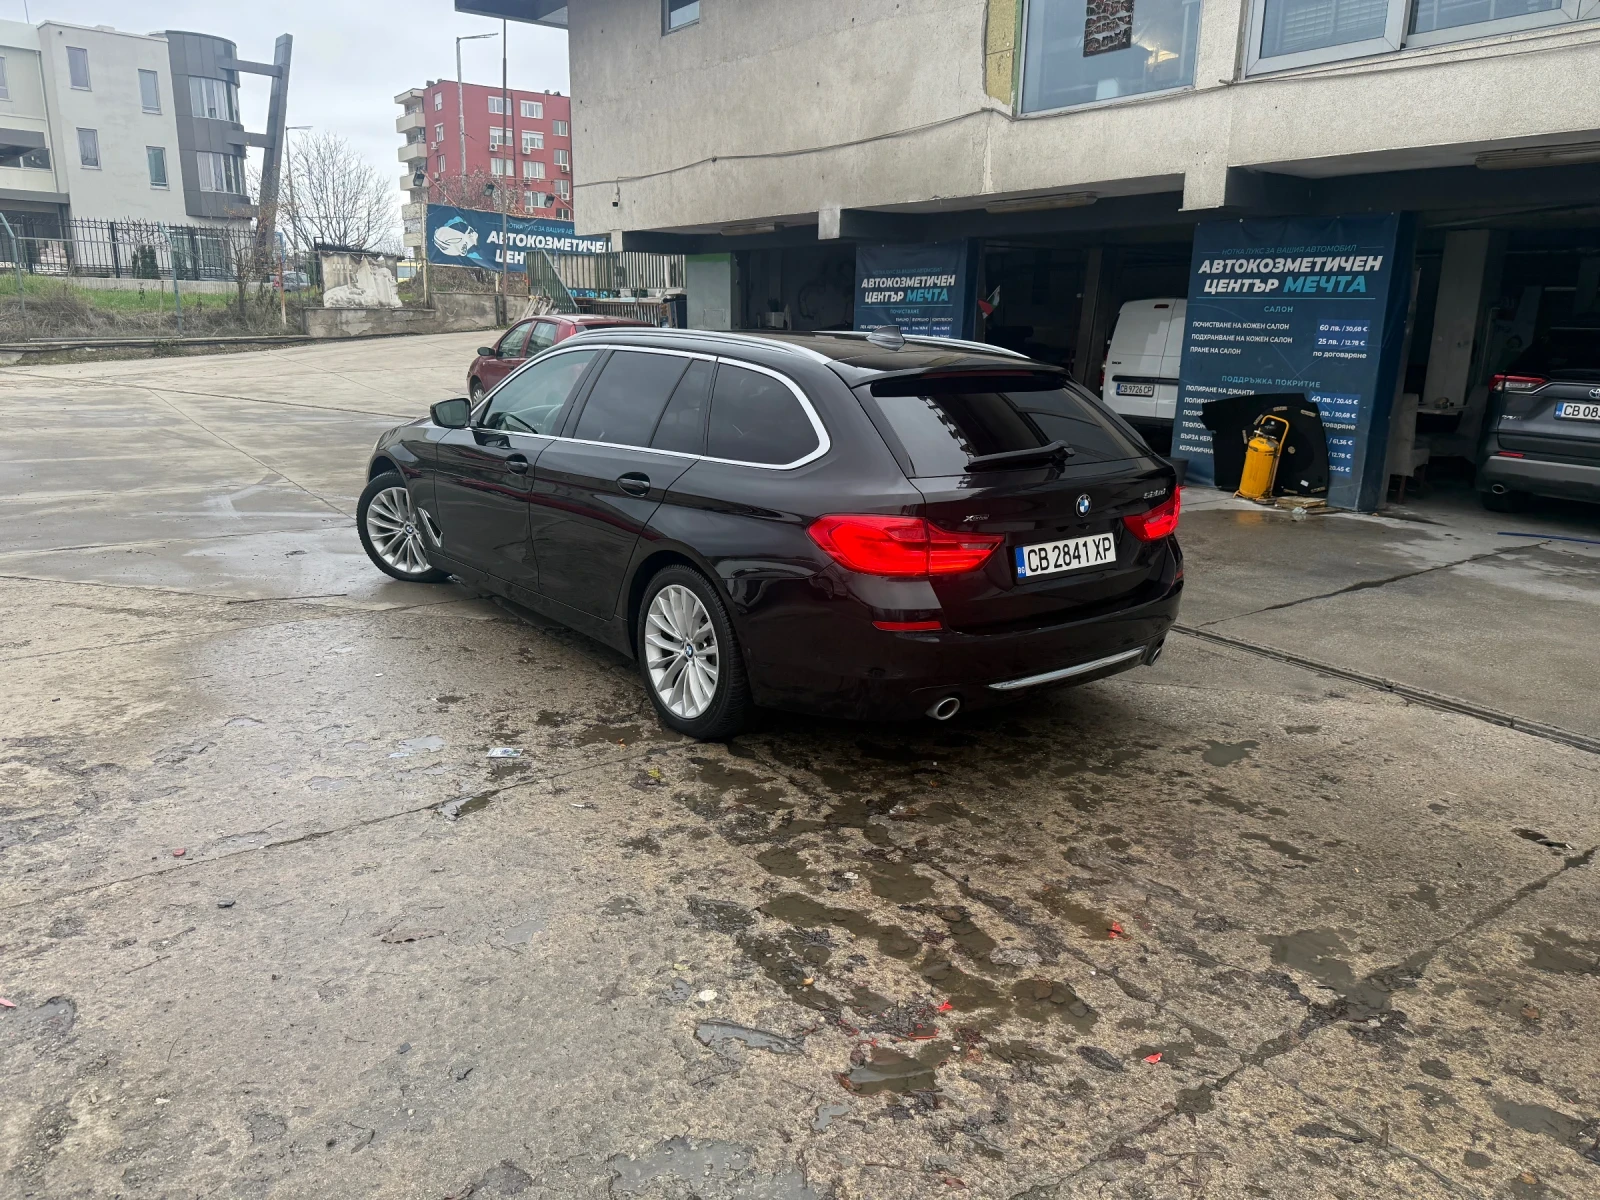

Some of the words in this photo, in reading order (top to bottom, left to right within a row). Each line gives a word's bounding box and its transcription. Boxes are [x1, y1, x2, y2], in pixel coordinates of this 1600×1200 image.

[506, 222, 524, 230] ОТКА
[1276, 246, 1305, 254] ВАШИЯ
[1305, 244, 1357, 253] АВТОМОБИЛ
[495, 250, 527, 264] ЦЕН
[1198, 255, 1383, 274] АВТОКОЗМЕТИЧЕН
[861, 274, 956, 288] АВТОКОЗМЕТИЧЕН
[1203, 278, 1280, 295] ЦЕНТЪР
[1282, 275, 1366, 293] МЕЧТА
[864, 291, 905, 304] ЦЕНТЪР
[905, 288, 949, 302] МЕЧТА
[1192, 321, 1232, 329] ПОЧИСТВАНЕ
[1191, 333, 1235, 341] ПОДХРАНВАНЕ
[1245, 335, 1269, 343] КОЖЕН
[1219, 347, 1241, 355] САЛОН
[1323, 351, 1367, 360] договаряне
[1221, 375, 1273, 385] ПОДДРЪЖКА
[1275, 378, 1321, 388] ПОКРИТИЕ
[1128, 385, 1142, 394] 9726
[1185, 385, 1218, 393] ПОЛИРАНЕ
[1227, 388, 1255, 396] ДЖАНТИ
[1563, 404, 1581, 417] CB
[1582, 406, 1600, 418] 08
[1322, 422, 1356, 430] говаряне
[1180, 433, 1199, 441] БЪРЗА
[1027, 547, 1050, 573] CB
[1051, 540, 1090, 569] 2841
[1092, 536, 1112, 562] XP
